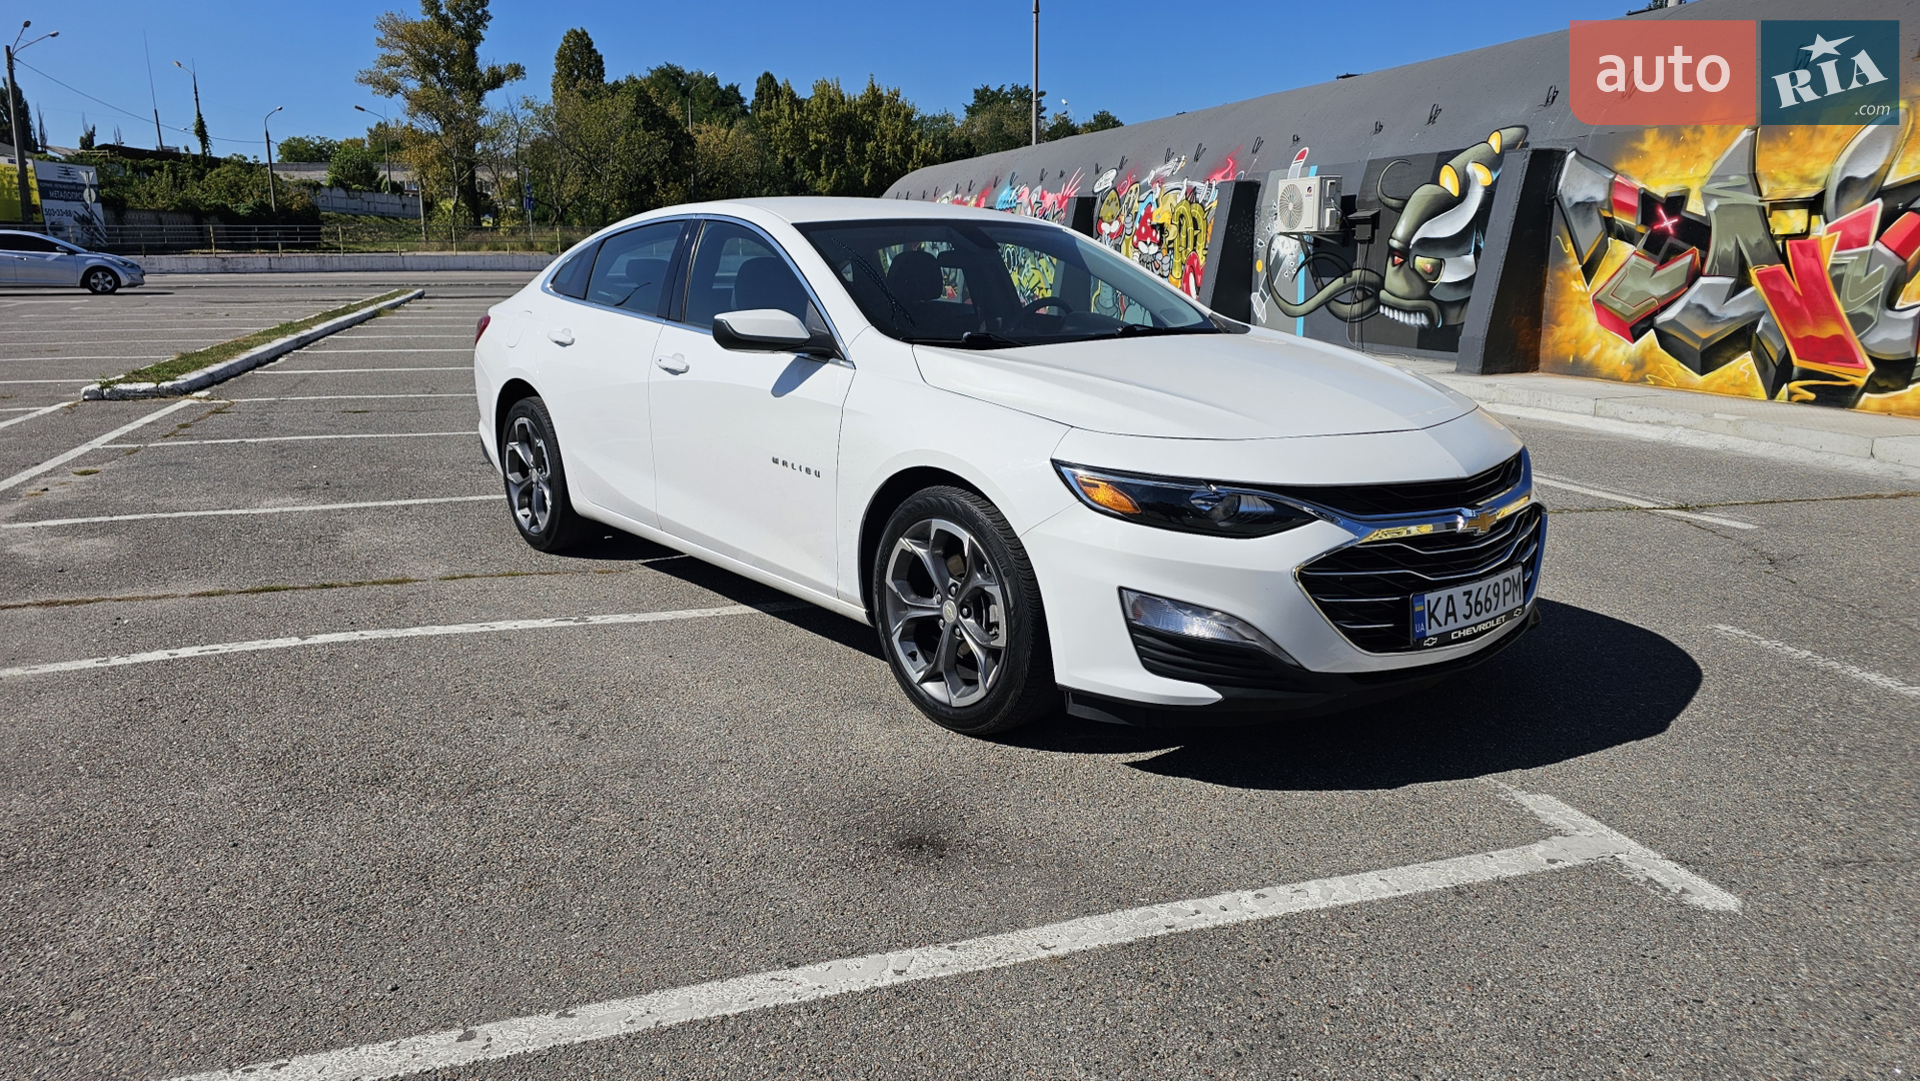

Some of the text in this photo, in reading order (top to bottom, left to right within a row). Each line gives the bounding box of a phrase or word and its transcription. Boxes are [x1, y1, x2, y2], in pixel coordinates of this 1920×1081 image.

[49, 190, 84, 200] МЕТАЛОПРО
[771, 456, 821, 478] MALIBU
[1427, 572, 1522, 630] KA 3669 PM
[1415, 622, 1426, 633] UA
[1451, 614, 1507, 640] CHEVROLET
